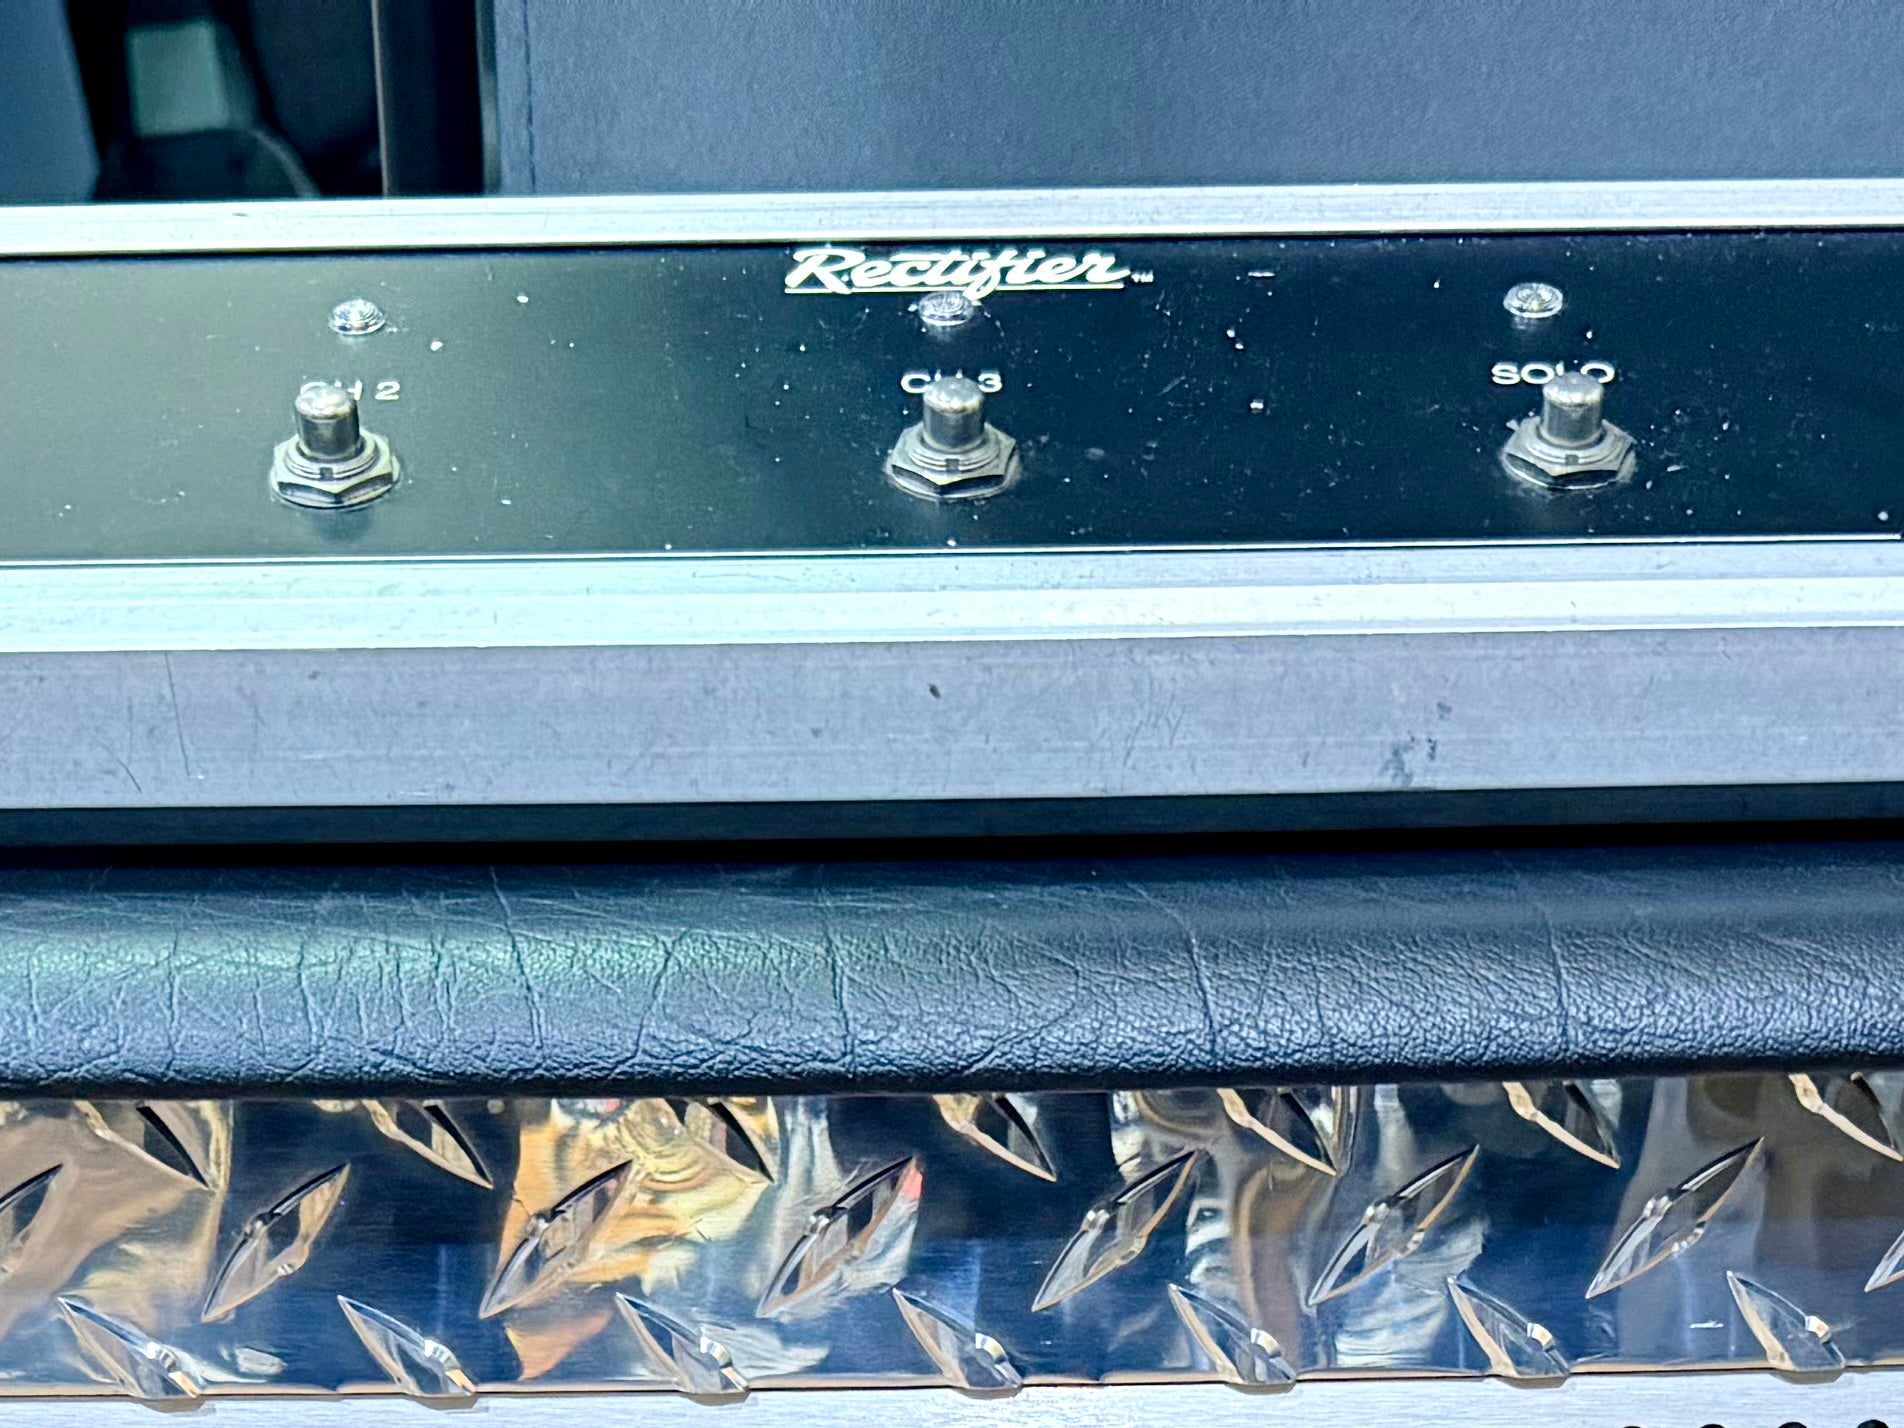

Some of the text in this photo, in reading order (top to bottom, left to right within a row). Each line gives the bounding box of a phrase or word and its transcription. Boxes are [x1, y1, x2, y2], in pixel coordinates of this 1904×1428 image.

[784, 248, 1131, 301] Rectifier
[374, 381, 401, 401] 2
[977, 372, 1003, 393] 3
